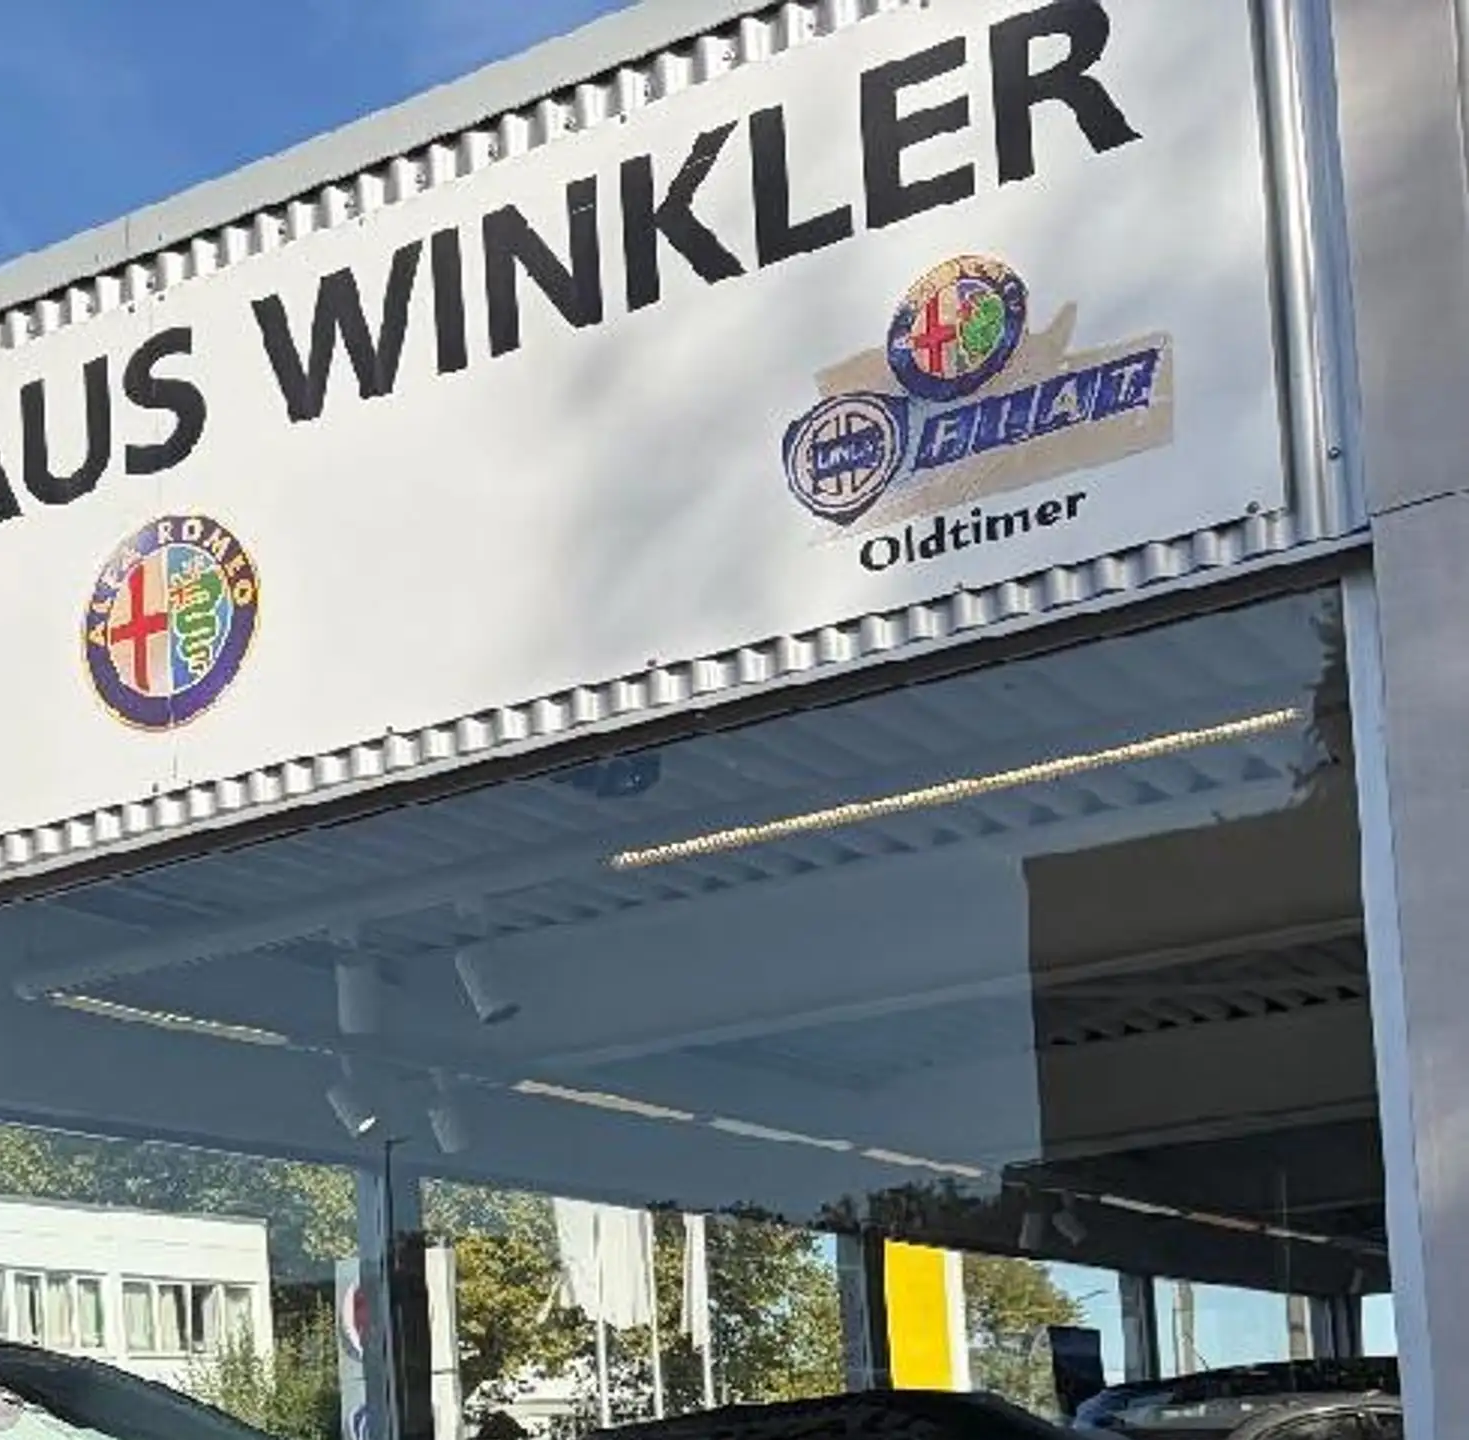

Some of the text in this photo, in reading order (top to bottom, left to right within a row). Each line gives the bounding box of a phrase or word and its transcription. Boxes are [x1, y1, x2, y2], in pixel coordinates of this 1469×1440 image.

[251, 0, 1143, 423] WINKLER
[920, 359, 1148, 459] FIAT
[156, 518, 255, 606] ROMEO
[859, 491, 1088, 572] Oldtimer
